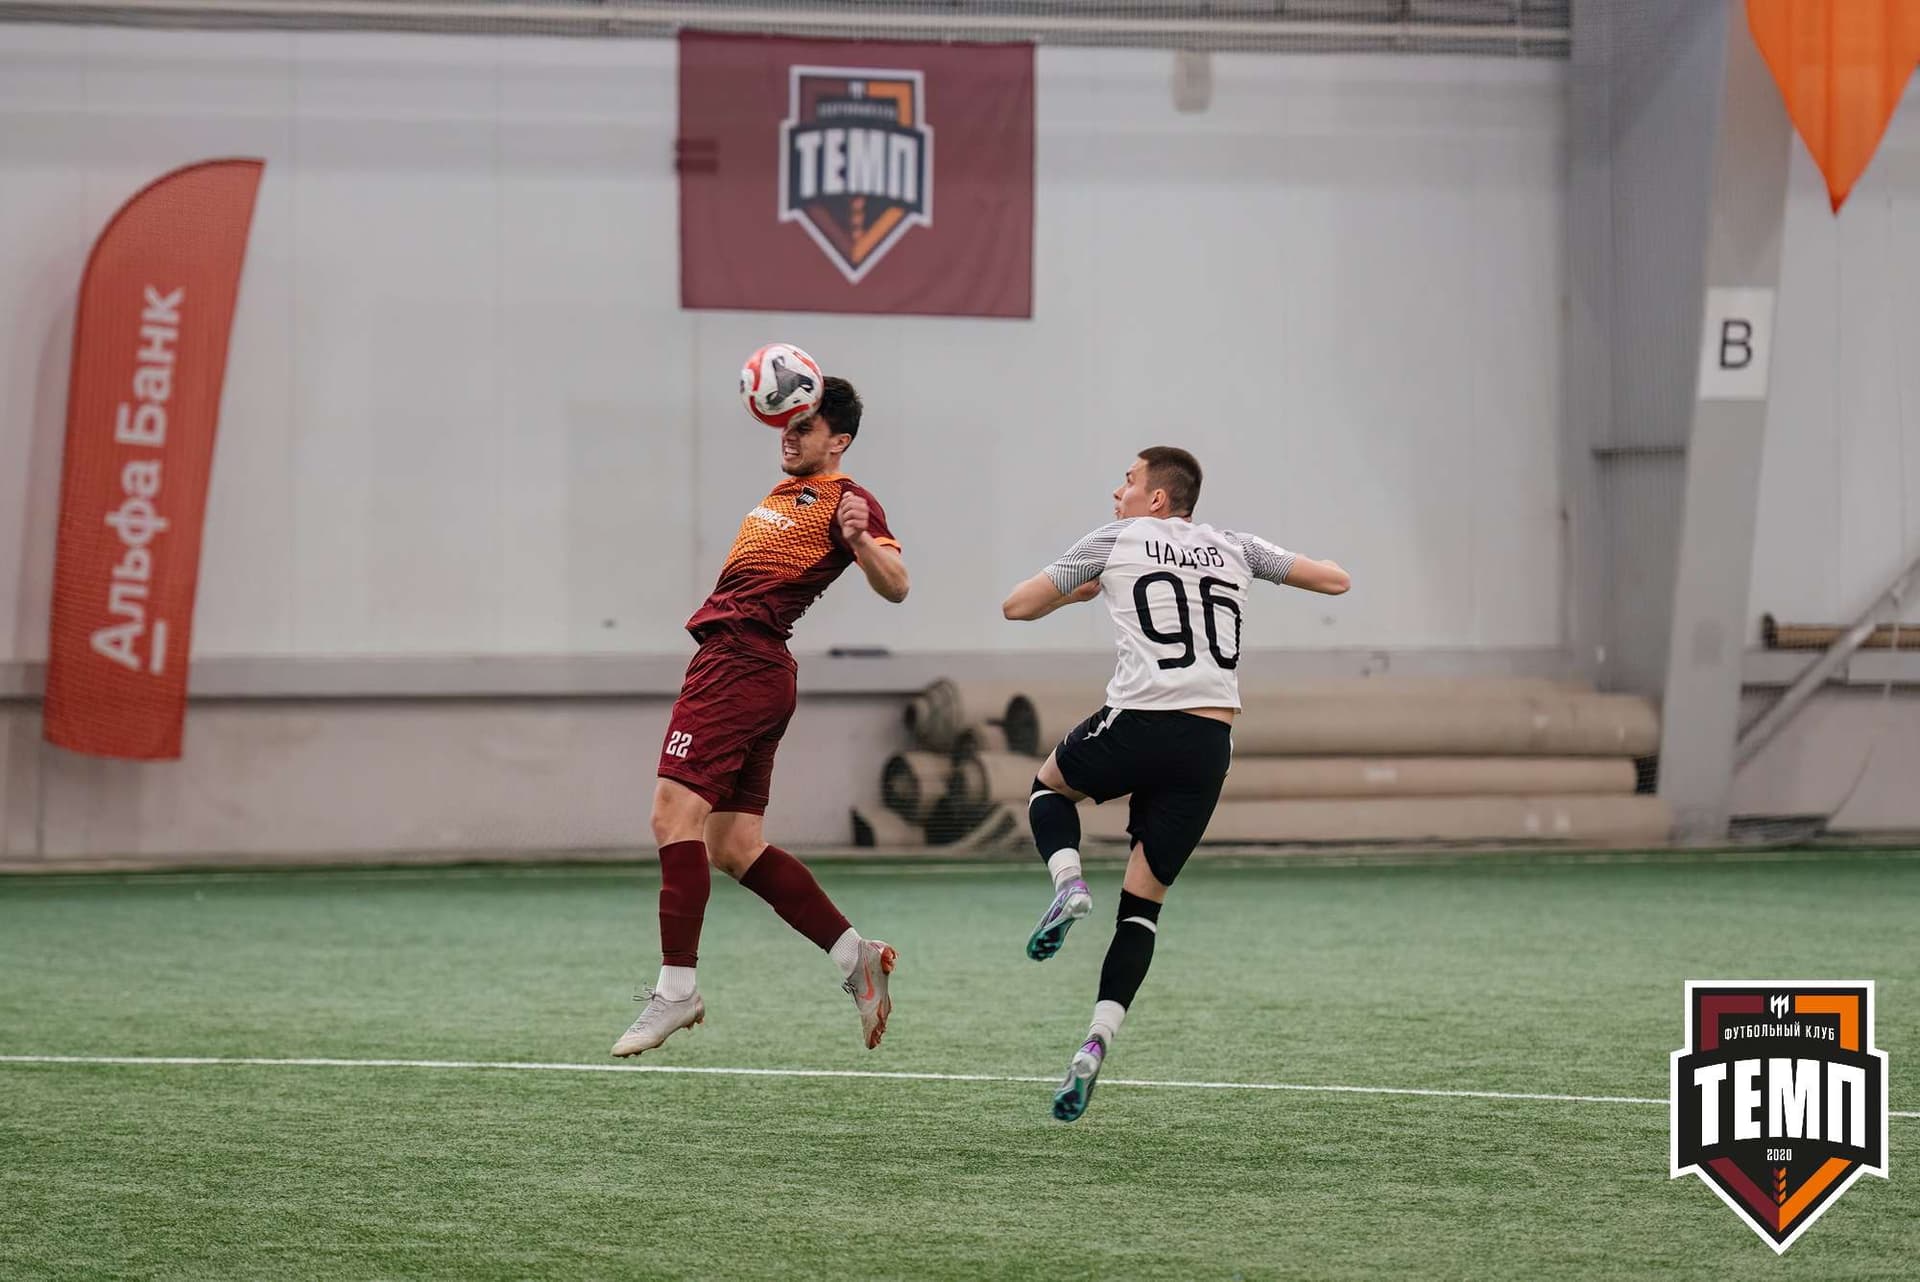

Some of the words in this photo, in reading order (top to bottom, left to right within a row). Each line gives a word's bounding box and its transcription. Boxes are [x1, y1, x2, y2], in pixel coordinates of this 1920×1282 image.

[795, 127, 919, 204] ТЕМП
[114, 285, 185, 447] Банк
[90, 460, 168, 671] Альфа
[1145, 541, 1225, 569] ЧАДОВ
[1133, 571, 1242, 670] 96
[665, 731, 693, 759] 22
